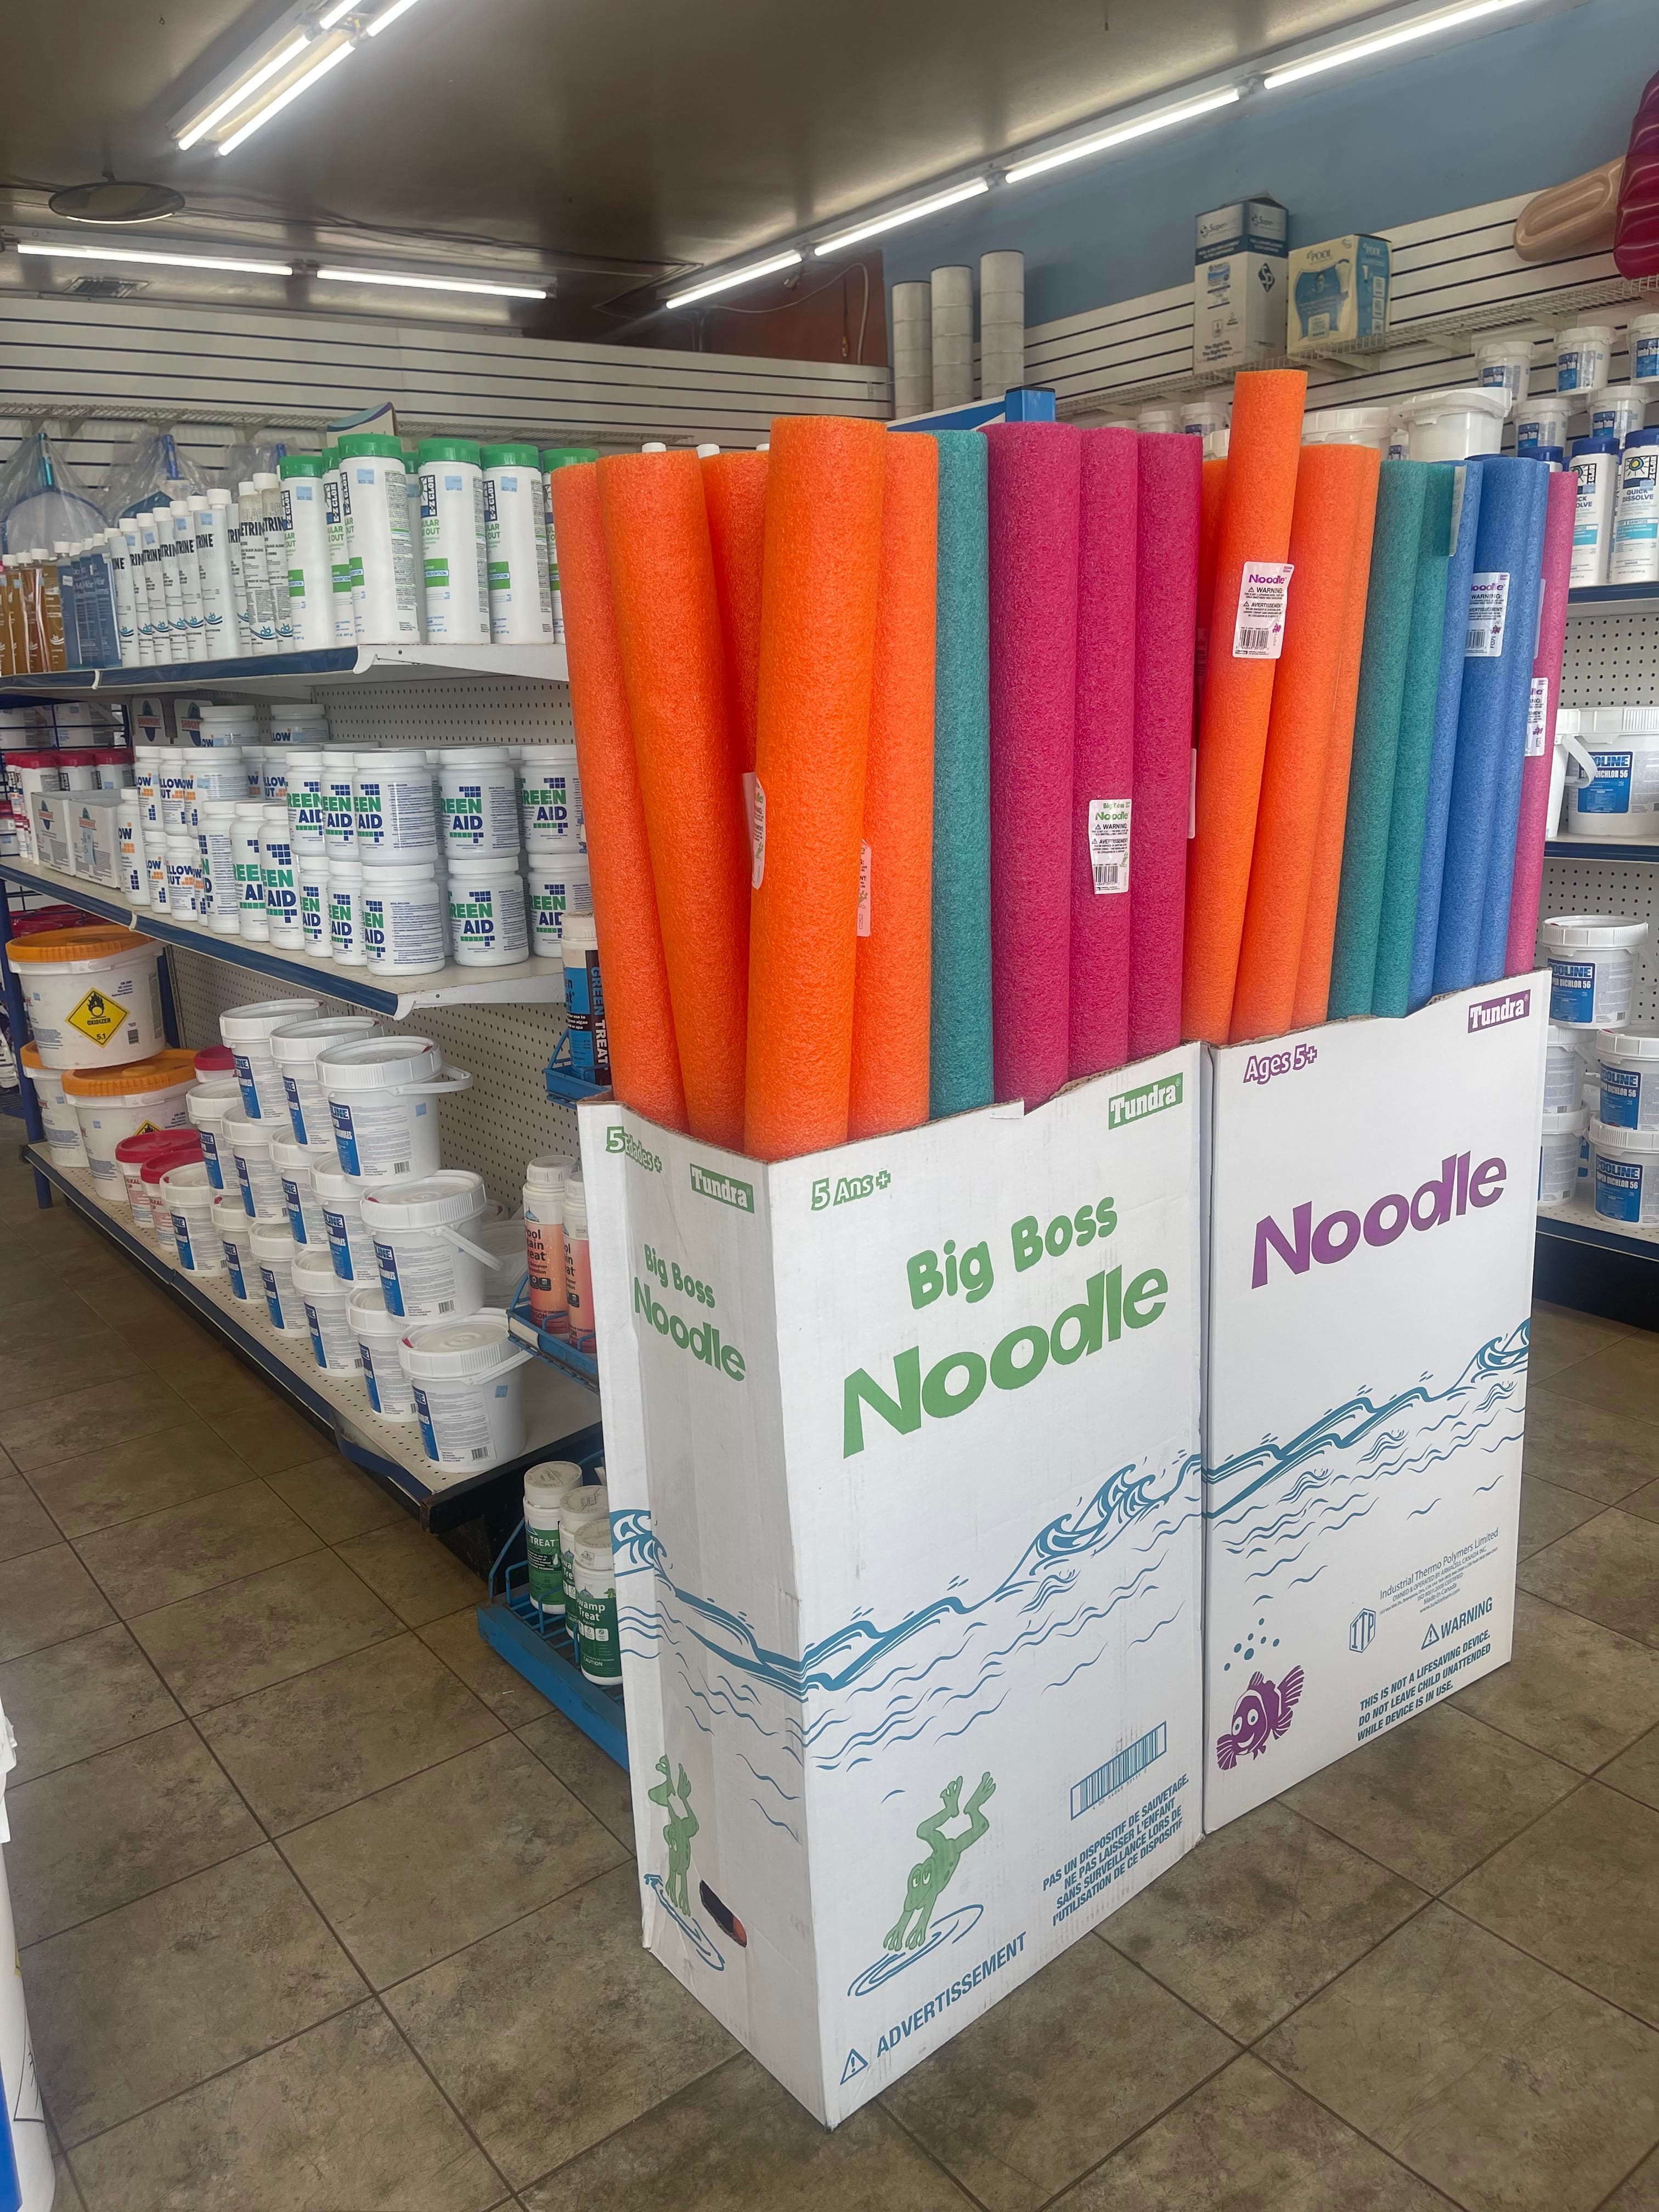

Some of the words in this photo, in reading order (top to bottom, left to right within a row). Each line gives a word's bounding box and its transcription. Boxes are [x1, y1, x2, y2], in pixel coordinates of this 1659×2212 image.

[1622, 494, 1654, 503] DISSOLVE
[1249, 574, 1285, 584] Noodle
[1619, 770, 1628, 778] 56
[327, 813, 352, 828] AID
[358, 814, 383, 829] AID
[453, 815, 483, 831] AID
[537, 806, 567, 821] AID
[1095, 811, 1128, 821] Noodle
[267, 890, 296, 907] AID
[449, 902, 493, 919] REEN
[302, 913, 321, 927] AID
[331, 921, 352, 936] AID
[365, 928, 385, 945] AID
[464, 919, 494, 934] AID
[590, 966, 605, 1016] GREEN
[1560, 980, 1582, 988] DICHLOR
[1582, 980, 1591, 989] 56
[1469, 994, 1526, 1031] Tundra
[595, 1019, 608, 1063] TREAT
[1243, 1048, 1291, 1085] Ages
[1292, 1043, 1318, 1070] 5+
[1109, 1080, 1178, 1126] Tundra
[1607, 1085, 1627, 1097] DICHLOR
[1628, 1089, 1637, 1097] 56
[606, 1126, 624, 1153] 5
[623, 1133, 654, 1172] Edades
[1596, 1158, 1640, 1179] POOLINE
[1607, 1175, 1629, 1188] DICHLOR
[1629, 1181, 1638, 1189] 56
[690, 1164, 751, 1210] Tundra
[811, 1177, 830, 1210] 5
[833, 1174, 874, 1206] Ans
[1251, 1150, 1507, 1290] Noodle
[906, 1239, 994, 1310] Big
[1011, 1197, 1118, 1273] Boss
[644, 1244, 669, 1288] Big
[671, 1262, 715, 1308] Boss
[634, 1277, 746, 1381] Noodle
[843, 1264, 1169, 1459] Noodle
[530, 1536, 555, 1547] TREAT
[1380, 1573, 1414, 1600] Industrial
[1415, 1561, 1442, 1581] Thermo
[1443, 1544, 1473, 1566] Polymers
[1475, 1527, 1499, 1549] Limited
[1413, 1575, 1435, 1591] OPERATED
[1462, 1552, 1479, 1564] CANADA
[1444, 1572, 1464, 1586] CERTIFIED
[1424, 1595, 1436, 1605] Made
[1441, 1582, 1457, 1595] Canada
[578, 1606, 600, 1622] Treat
[1351, 1611, 1375, 1651] ITP
[1441, 1596, 1493, 1639] WARNING
[583, 1656, 603, 1667] CAUTION
[1359, 1692, 1378, 1711] THIS
[1381, 1686, 1389, 1700] IS
[1391, 1675, 1408, 1694] NOT
[1409, 1672, 1415, 1684] A
[1417, 1646, 1460, 1680] LIFESAVING
[1463, 1629, 1491, 1654] DEVICE.
[1359, 1713, 1370, 1727] DO
[1372, 1701, 1389, 1720] NOT
[1391, 1689, 1415, 1709] LEAVE
[1418, 1674, 1441, 1696] CHILD
[1442, 1643, 1491, 1683] UNATTENDED
[1357, 1720, 1383, 1742] WHILE
[1385, 1704, 1414, 1725] DEVICE
[1415, 1697, 1424, 1709] IS
[1425, 1690, 1435, 1703] IN
[1436, 1680, 1453, 1699] USE.
[1043, 1871, 1062, 1892] PAS
[1064, 1857, 1077, 1874] UN
[1079, 1820, 1127, 1864] DISPOSITIF
[1128, 1810, 1140, 1827] DE
[1141, 1773, 1189, 1819] SAUVETAGE.
[1064, 1871, 1077, 1890] NE
[1079, 1859, 1097, 1880] PAS
[1098, 1831, 1135, 1865] LAISSER
[1136, 1797, 1176, 1835] L'ENFANT
[1113, 1866, 1126, 1880] DE
[1126, 1853, 1139, 1871] CE
[1139, 1817, 1183, 1860] DISPOSITIF
[1057, 1882, 1082, 1910] SANS
[1084, 1833, 1147, 1889] SURVEILLANCE
[1148, 1816, 1170, 1840] LORS
[1171, 1804, 1182, 1824] DE
[877, 1931, 1027, 2058] ADVERTISSEMENT
